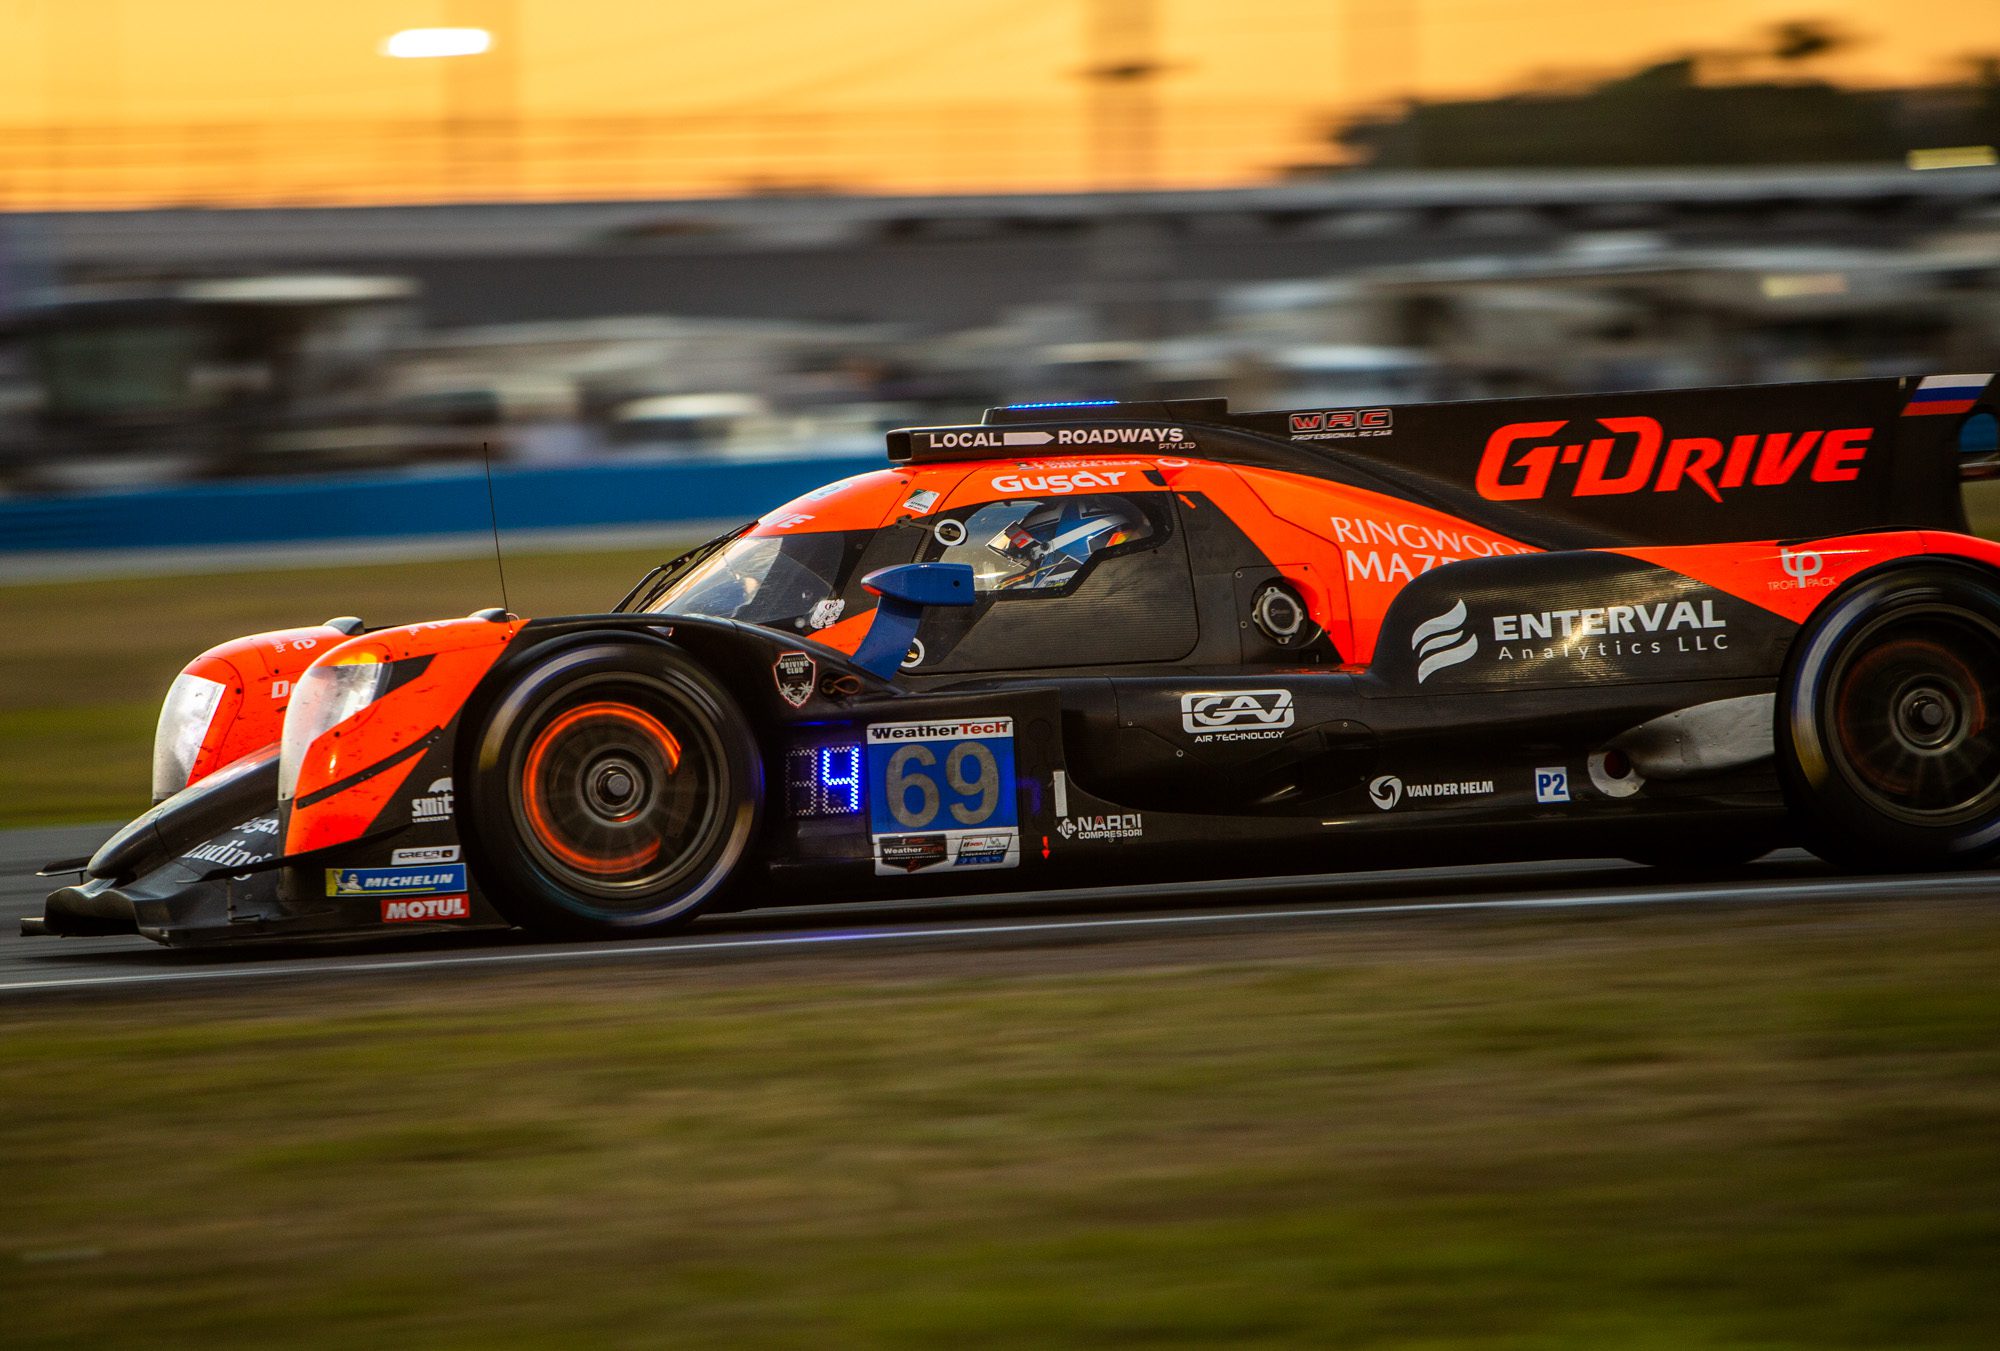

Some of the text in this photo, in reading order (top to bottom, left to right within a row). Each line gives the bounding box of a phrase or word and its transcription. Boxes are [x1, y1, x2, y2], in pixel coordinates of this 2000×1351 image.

[1292, 412, 1388, 429] WRC
[930, 428, 1184, 448] LOCAL ROADWAYS
[1330, 516, 1535, 558] RINGWOO
[1493, 599, 1727, 641] ENTERVAL
[1498, 634, 1729, 660] Analytics LLC
[780, 660, 809, 669] DRIVING
[786, 666, 804, 675] CLUB
[873, 721, 1008, 739] WeatherTech
[1194, 731, 1285, 743] AIR TECHNOLOGY
[886, 741, 999, 828] 69
[1406, 780, 1494, 798] VAN DER HELM
[1538, 773, 1567, 797] P2
[1077, 814, 1142, 832] NARDI
[1078, 828, 1143, 840] COMPRESSORI
[364, 873, 455, 888] MICHELIN
[385, 898, 466, 919] MOTUL
